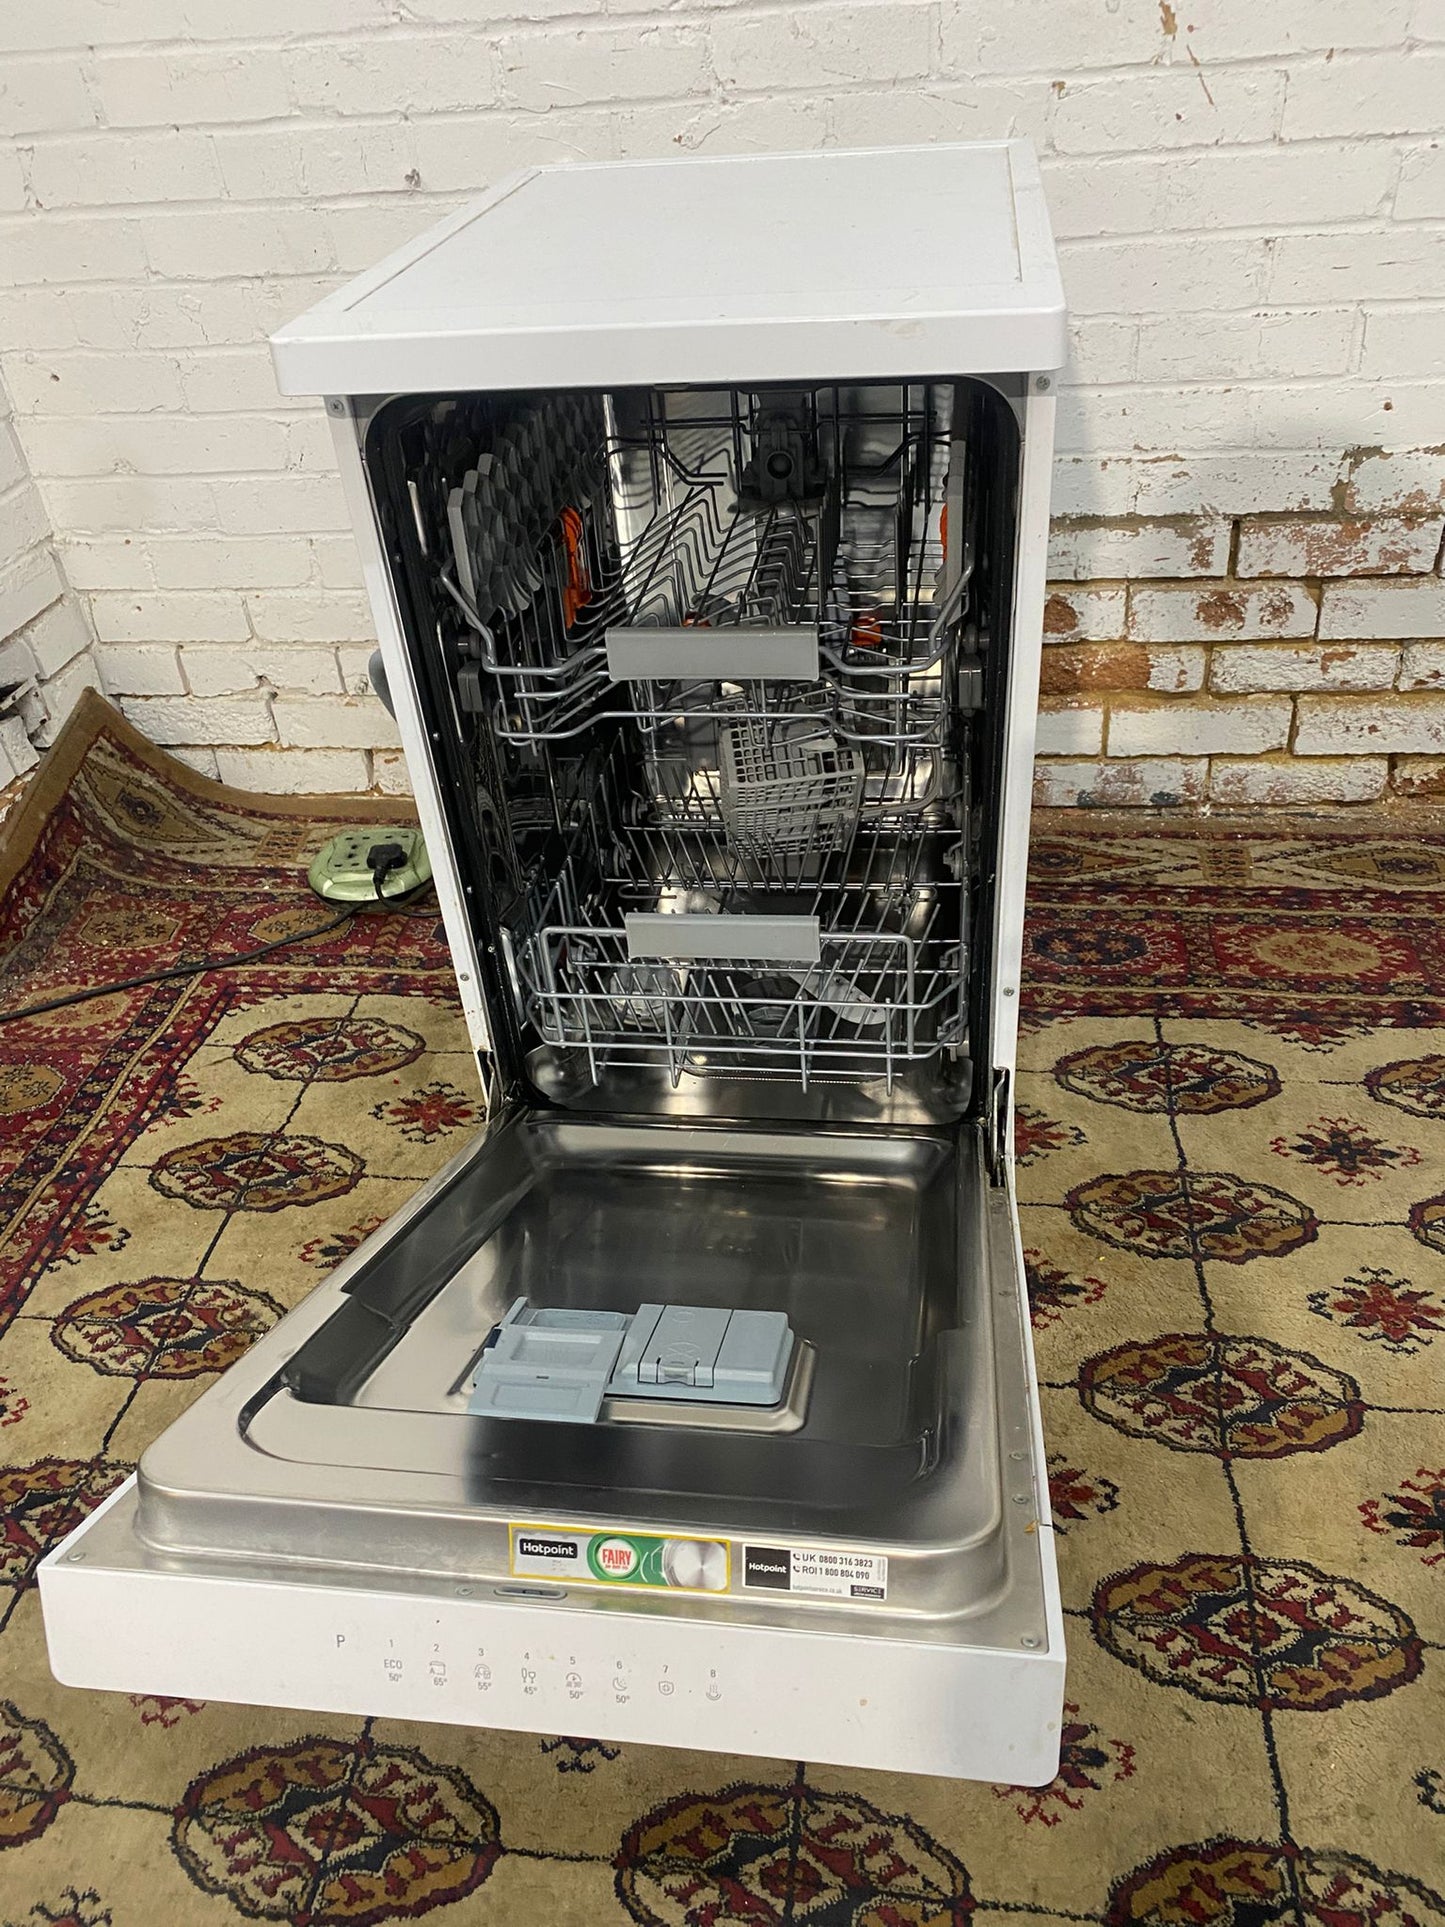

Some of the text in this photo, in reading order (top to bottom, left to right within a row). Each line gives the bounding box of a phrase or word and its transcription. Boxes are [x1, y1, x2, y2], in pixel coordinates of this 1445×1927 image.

[523, 1542, 575, 1556] Hotpoint
[602, 1548, 632, 1565] FAIRY
[802, 1554, 873, 1568] UK 0800 316 3823
[748, 1562, 787, 1573] Hotpoint
[802, 1565, 818, 1575] ROI
[825, 1568, 839, 1577] 800
[840, 1569, 854, 1578] 804
[855, 1571, 870, 1580] 090
[853, 1585, 882, 1593] SERVICE
[336, 1634, 345, 1648] P
[389, 1639, 394, 1648] 1
[433, 1643, 440, 1652] 2
[478, 1648, 485, 1657] 3
[523, 1652, 530, 1660] 4
[383, 1659, 403, 1670] ECO
[569, 1657, 576, 1665] 5
[616, 1661, 623, 1669] 6
[662, 1665, 668, 1673] 7
[710, 1669, 716, 1678] 8
